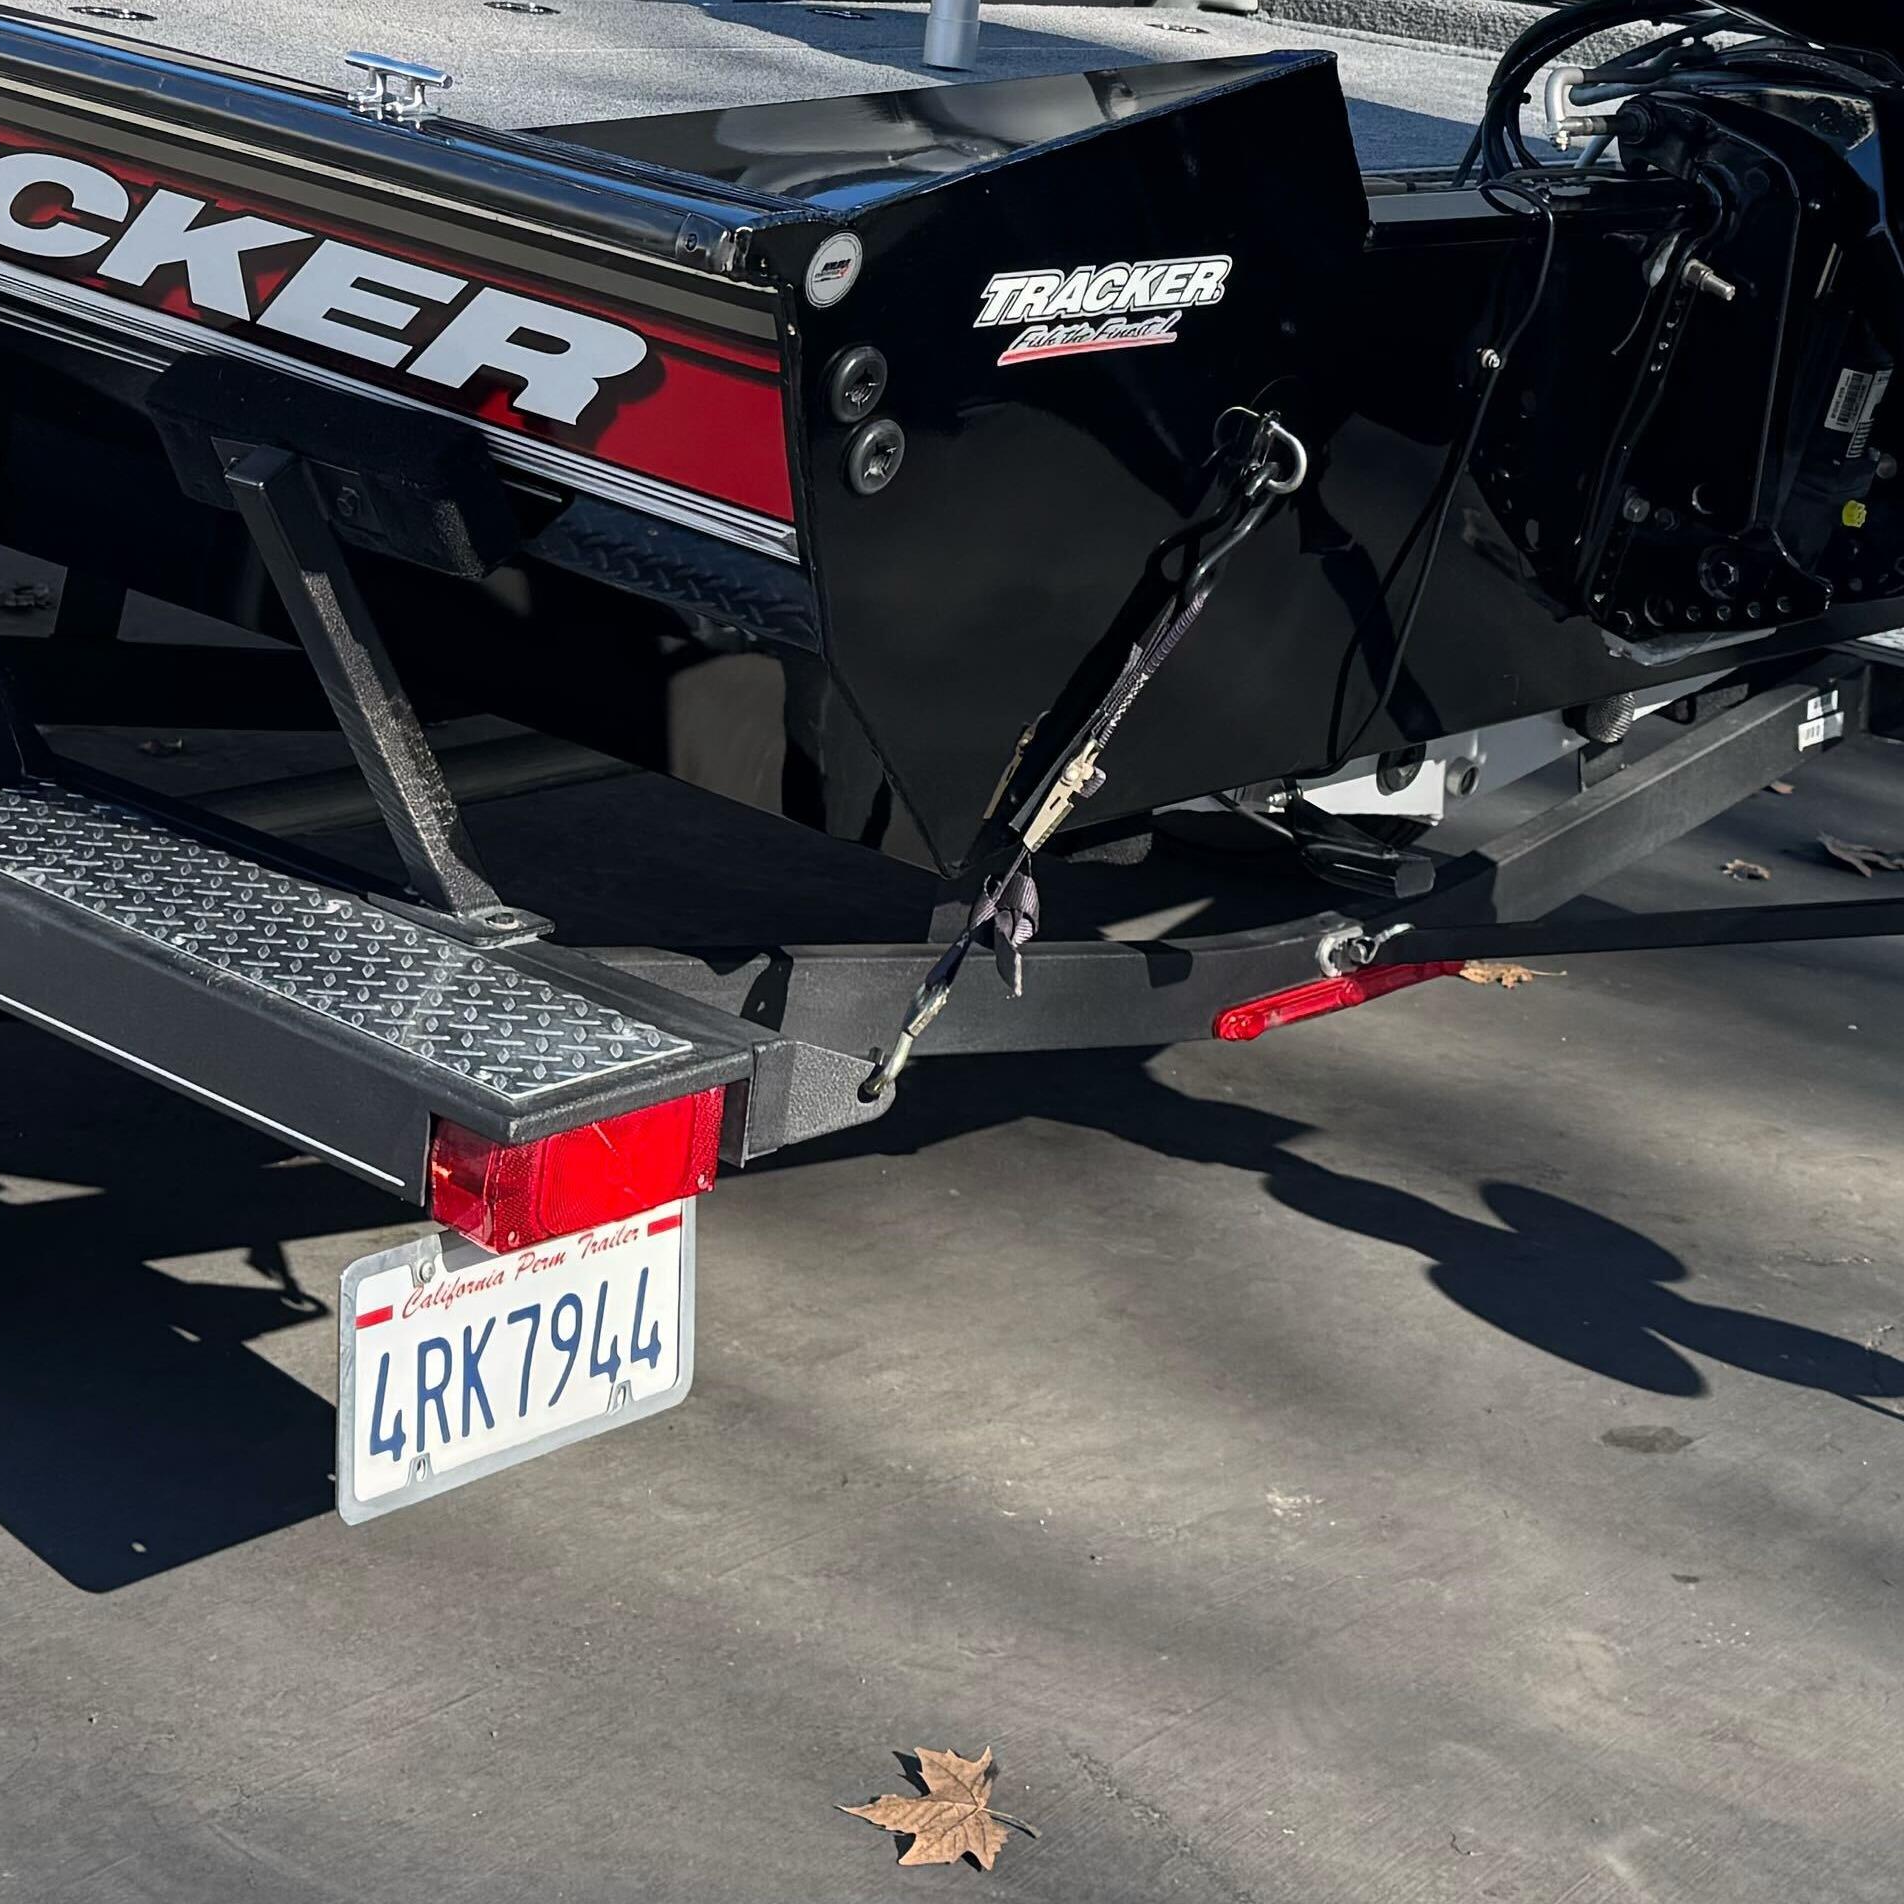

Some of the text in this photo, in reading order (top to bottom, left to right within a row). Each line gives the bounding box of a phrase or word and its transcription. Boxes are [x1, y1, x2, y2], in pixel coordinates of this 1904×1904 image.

[975, 256, 1230, 327] TRACKER
[402, 1227, 640, 1319] California Perm Trailer
[369, 1267, 662, 1462] 4RK7944
